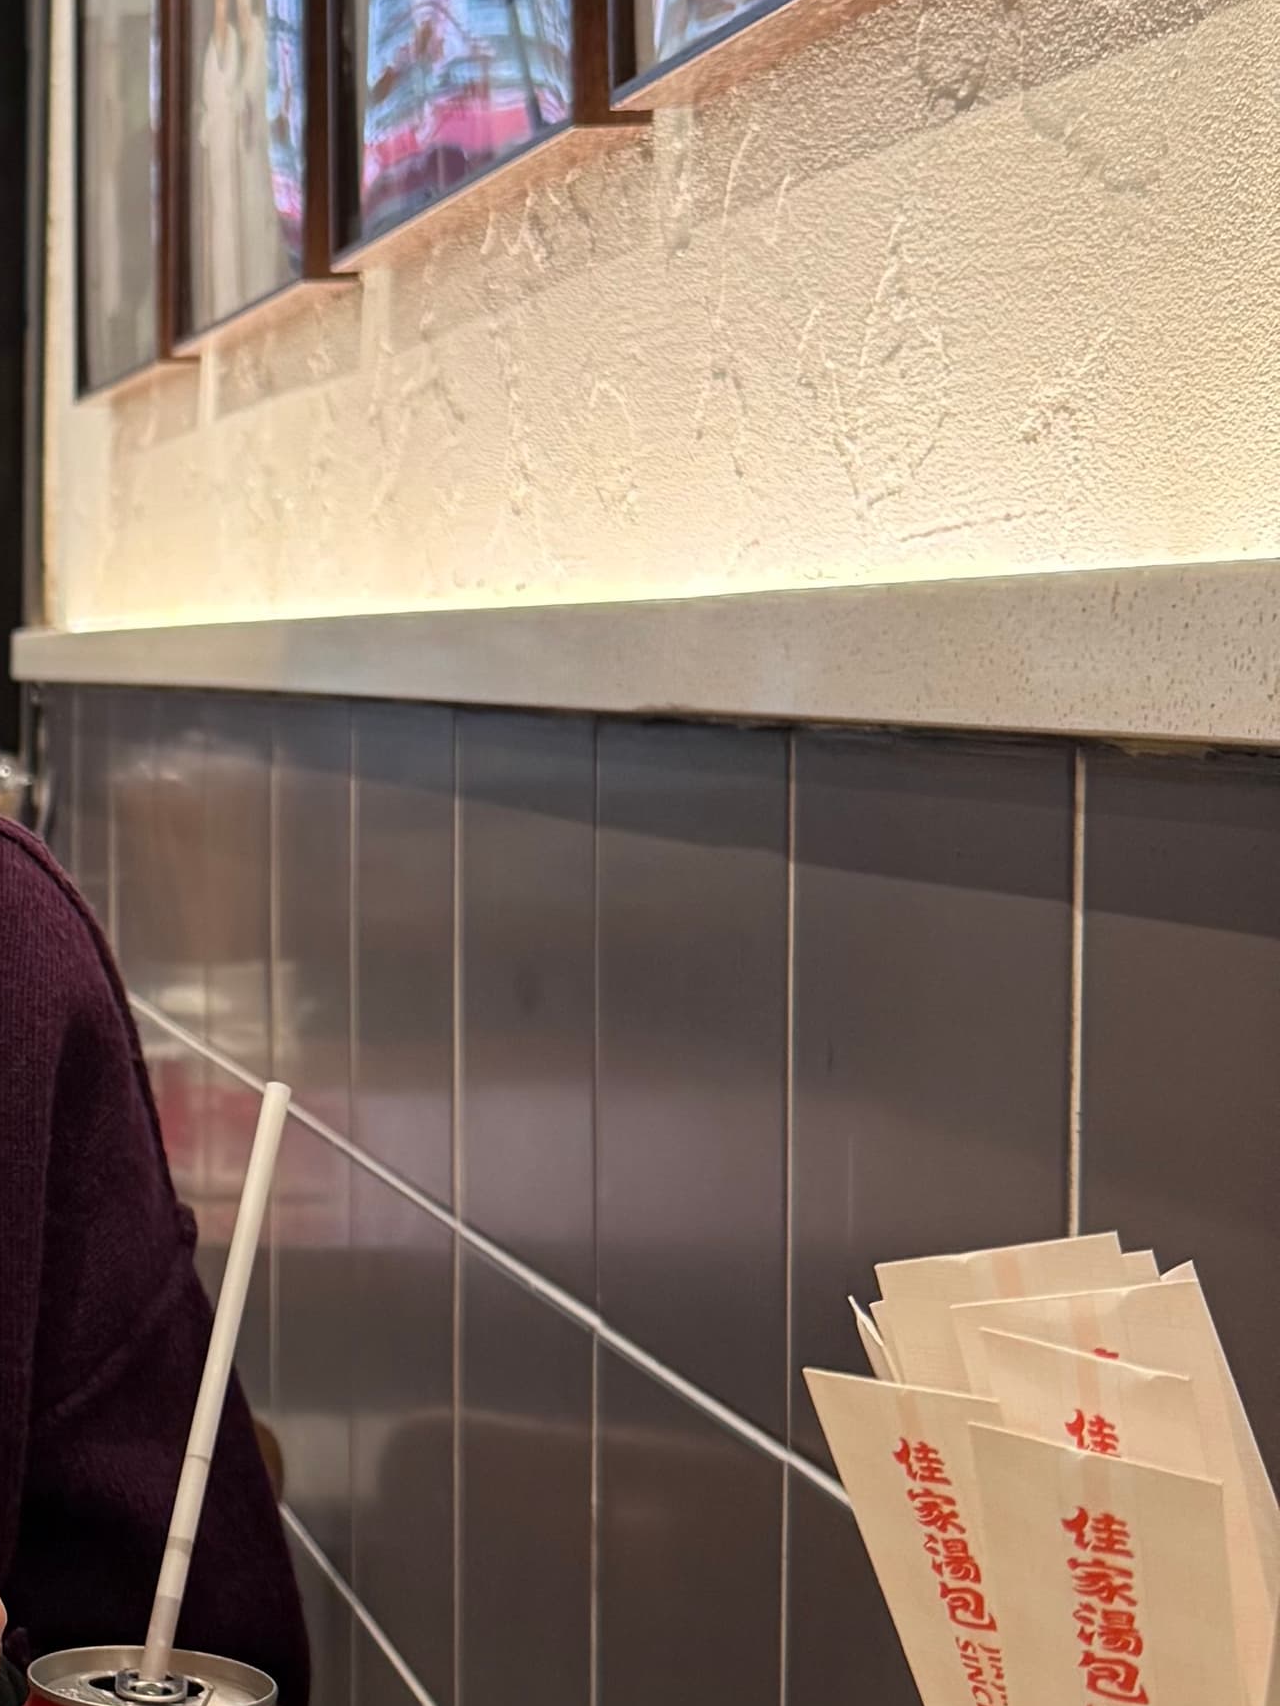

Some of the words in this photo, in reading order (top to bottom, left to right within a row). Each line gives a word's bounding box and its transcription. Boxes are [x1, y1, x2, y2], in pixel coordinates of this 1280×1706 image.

[892, 1436, 998, 1633] 佳家湯包
[1061, 1506, 1150, 1706] 佳家湯包
